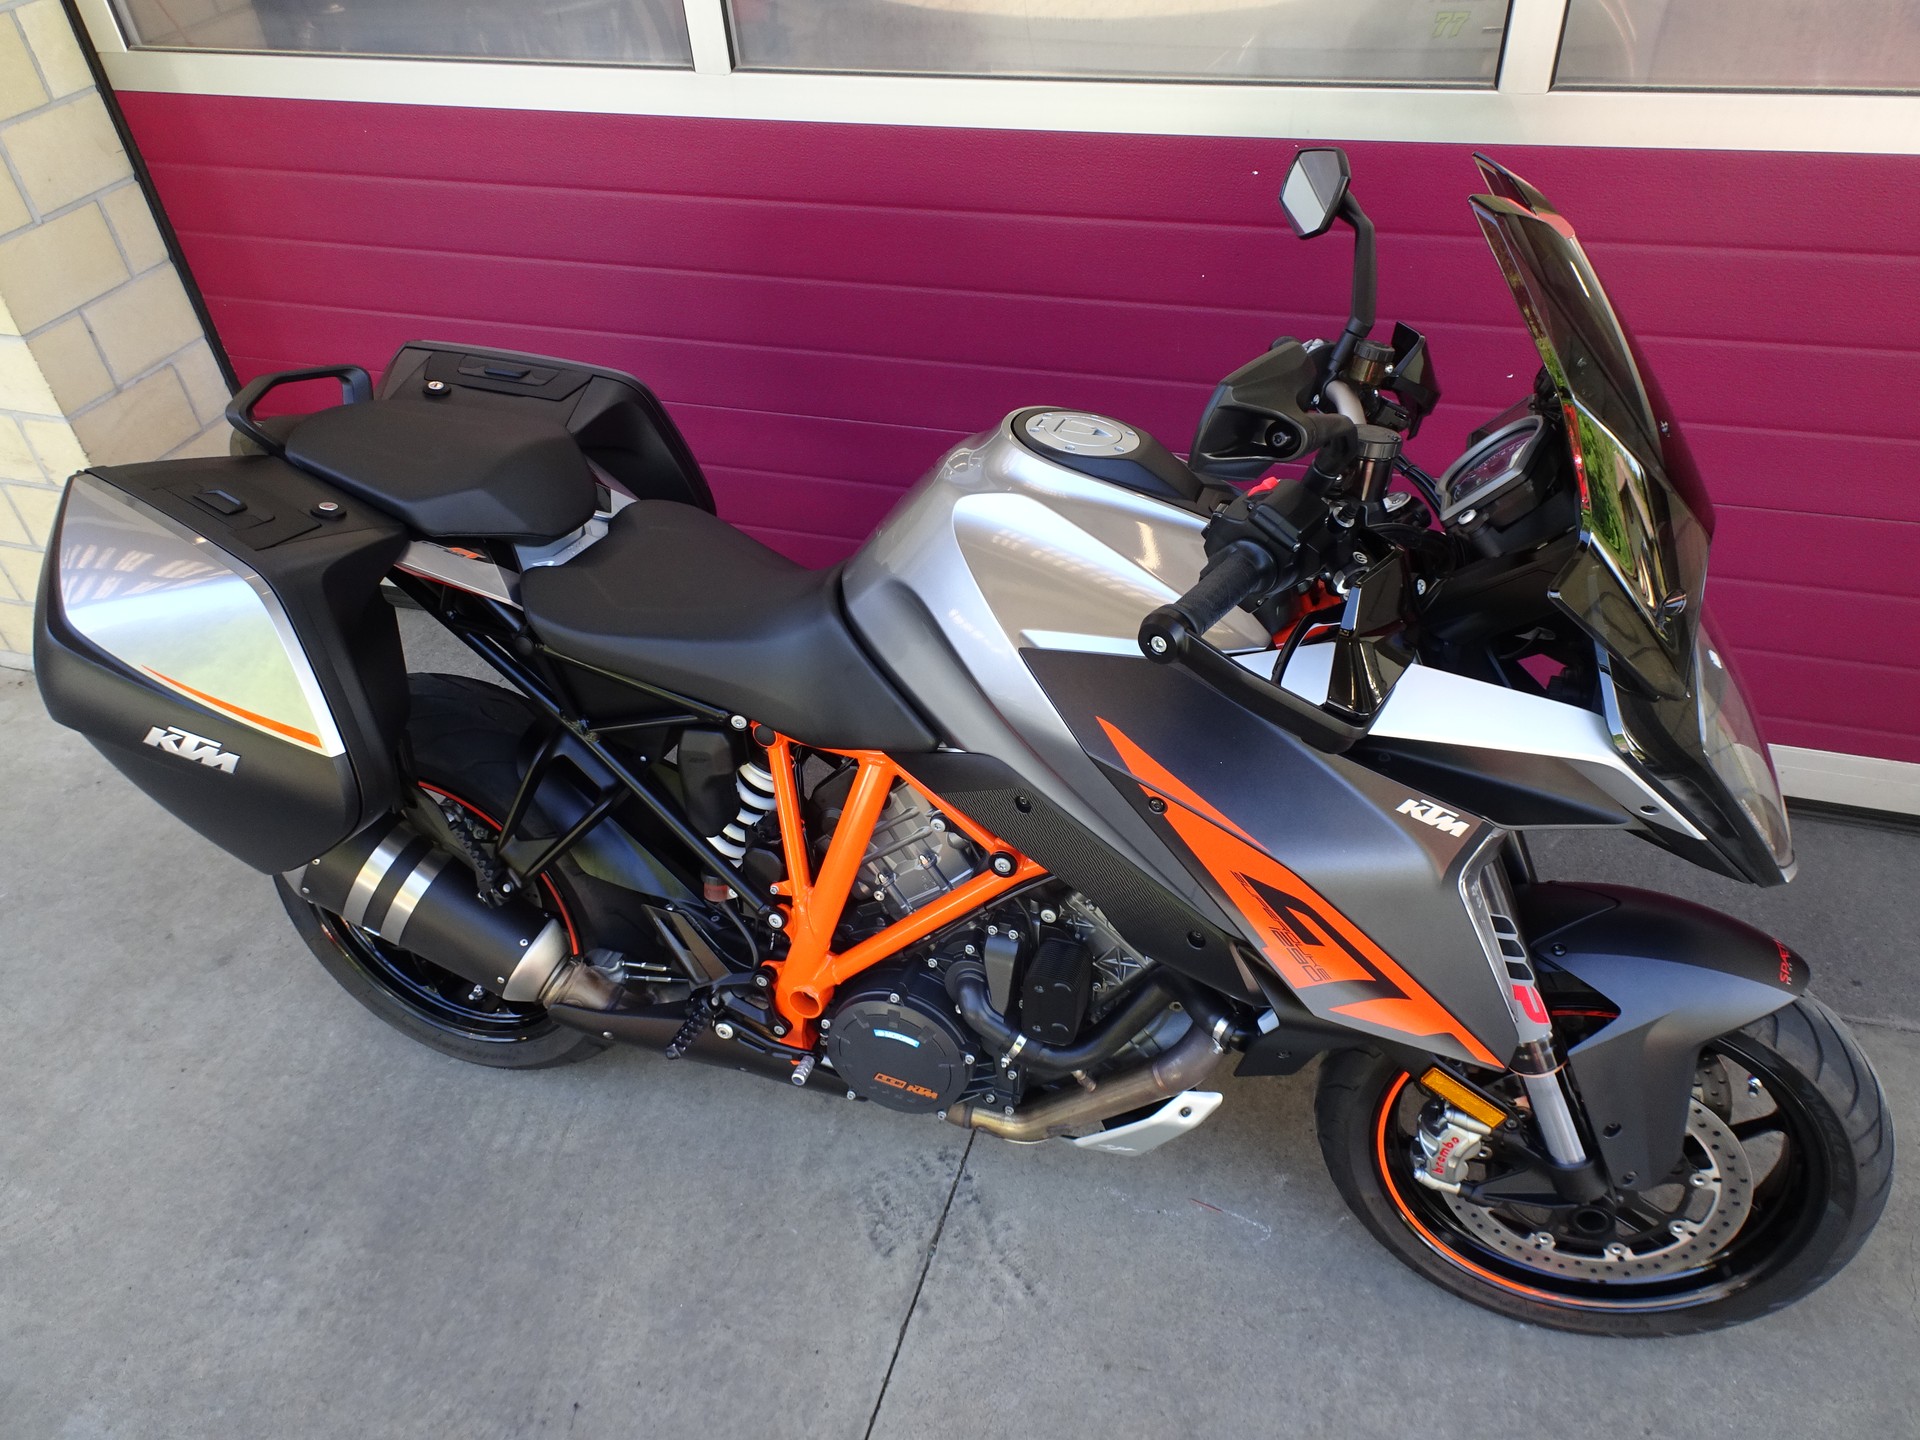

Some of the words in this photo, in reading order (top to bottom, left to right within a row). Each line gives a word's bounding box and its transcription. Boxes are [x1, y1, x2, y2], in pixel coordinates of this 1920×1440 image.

[1432, 11, 1471, 38] 77
[143, 726, 240, 774] KTM
[1395, 798, 1470, 837] KTM
[1268, 926, 1323, 982] 1290
[1432, 1136, 1460, 1174] brembo
